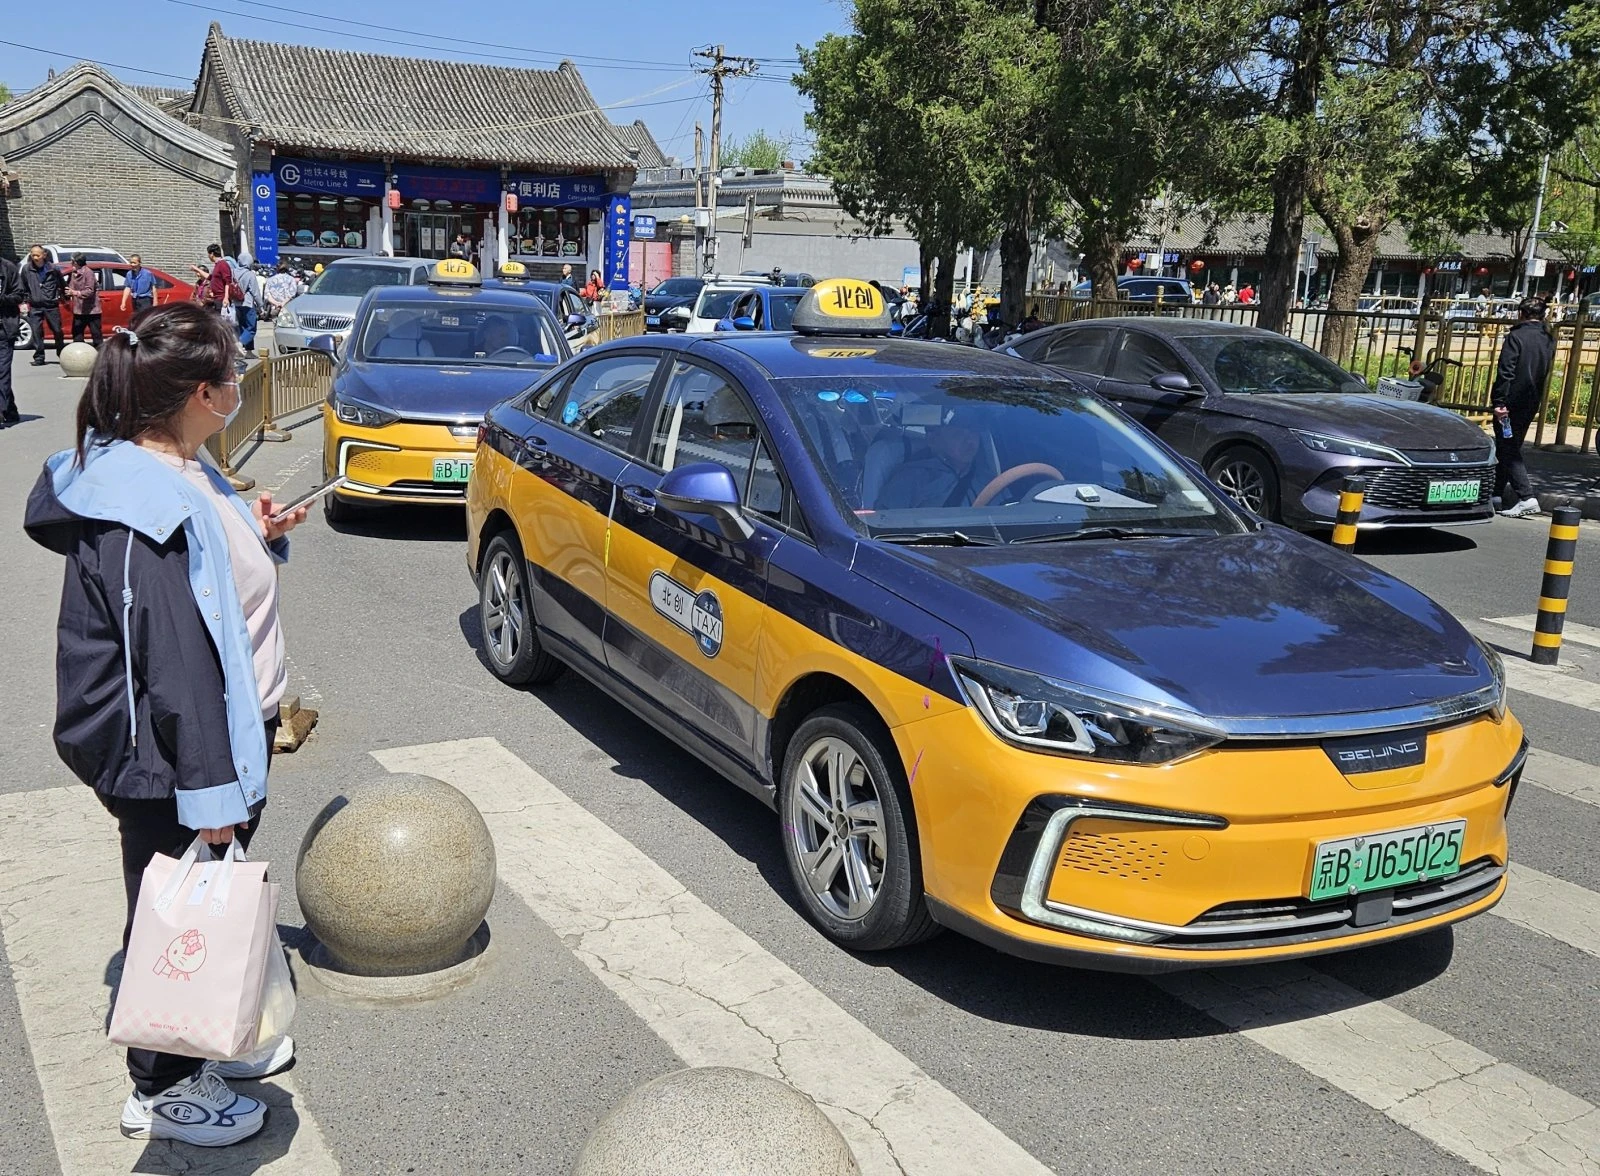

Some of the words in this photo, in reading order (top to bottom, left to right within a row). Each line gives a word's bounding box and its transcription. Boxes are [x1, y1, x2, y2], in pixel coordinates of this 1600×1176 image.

[304, 167, 348, 179] 地铁4号线
[304, 179, 324, 187] Metro
[326, 180, 341, 188] Line
[518, 181, 560, 199] 便利店
[444, 261, 467, 274] 北方
[831, 285, 874, 309] 北创
[662, 586, 684, 615] 北创
[695, 608, 720, 640] TAXI
[1338, 742, 1419, 761] BEIJING
